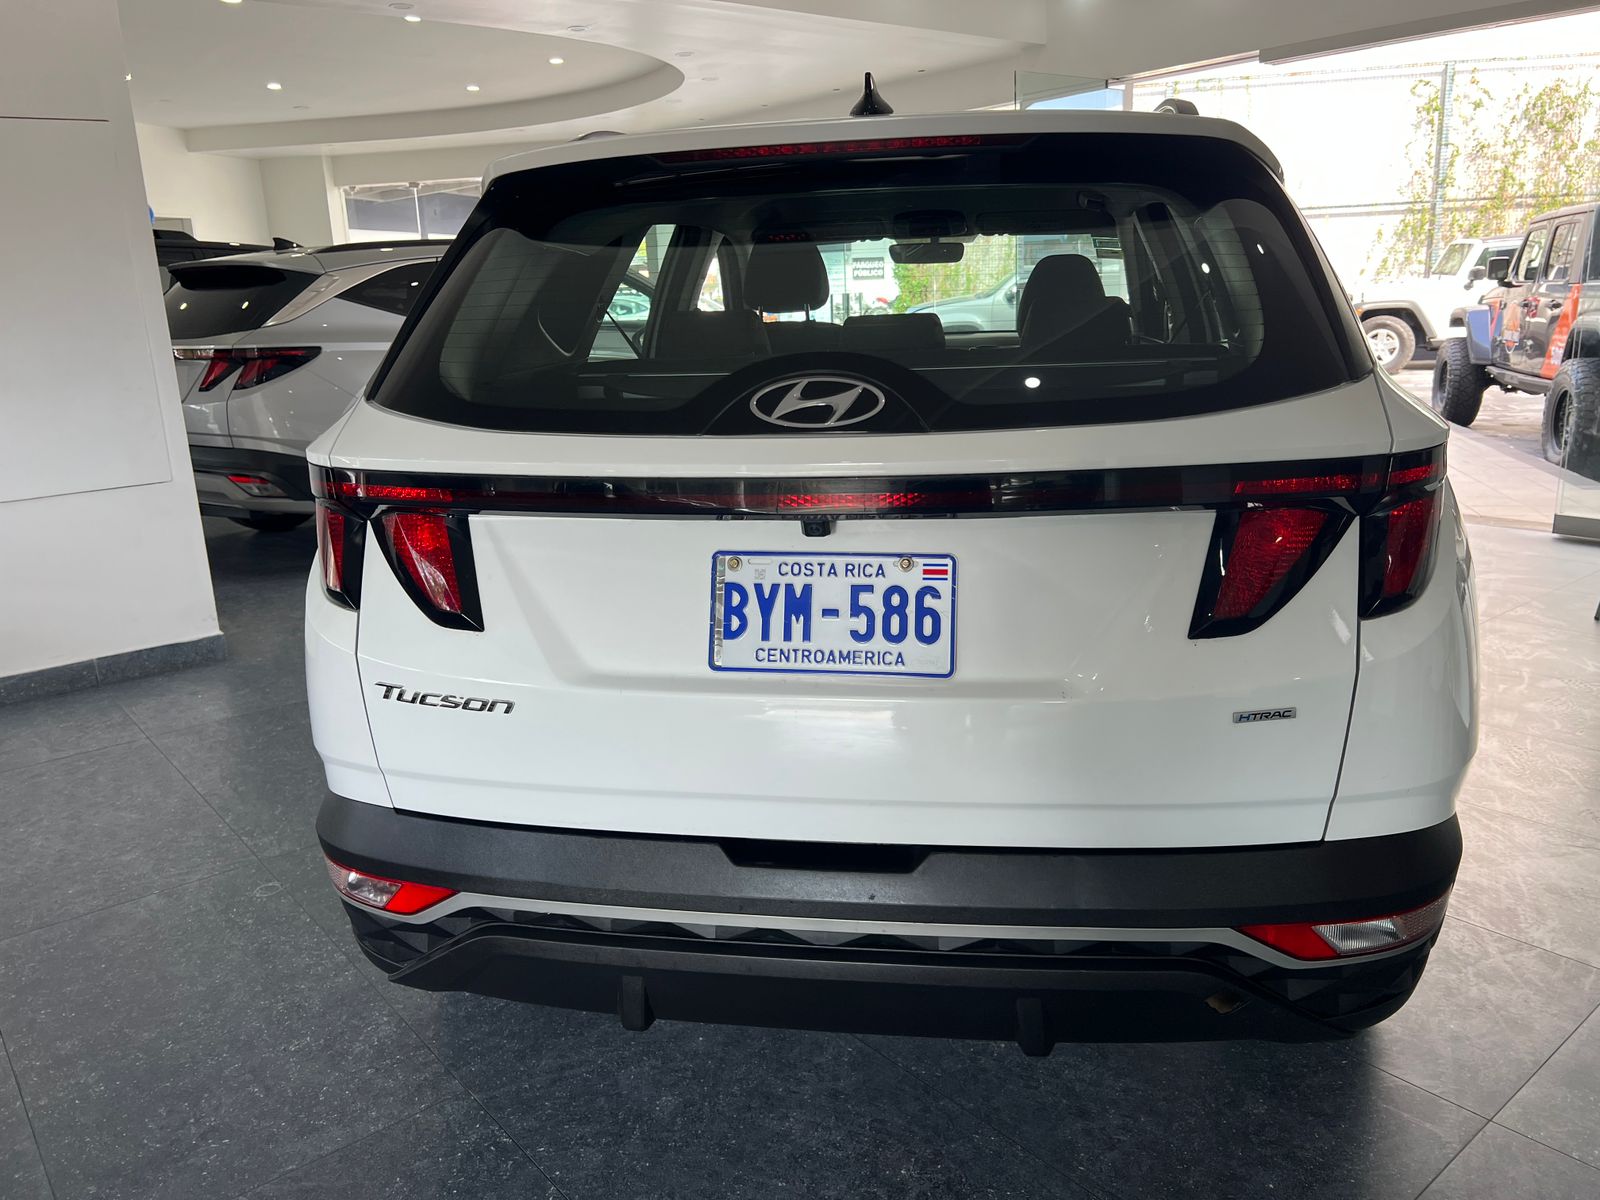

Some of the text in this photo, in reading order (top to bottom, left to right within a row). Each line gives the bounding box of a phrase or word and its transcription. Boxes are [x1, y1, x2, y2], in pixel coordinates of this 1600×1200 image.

[778, 562, 838, 577] COSTA
[844, 563, 886, 579] RICA
[722, 582, 942, 645] BYM-586
[755, 648, 905, 666] CENTROAMERICA
[1238, 709, 1292, 722] HTRAC
